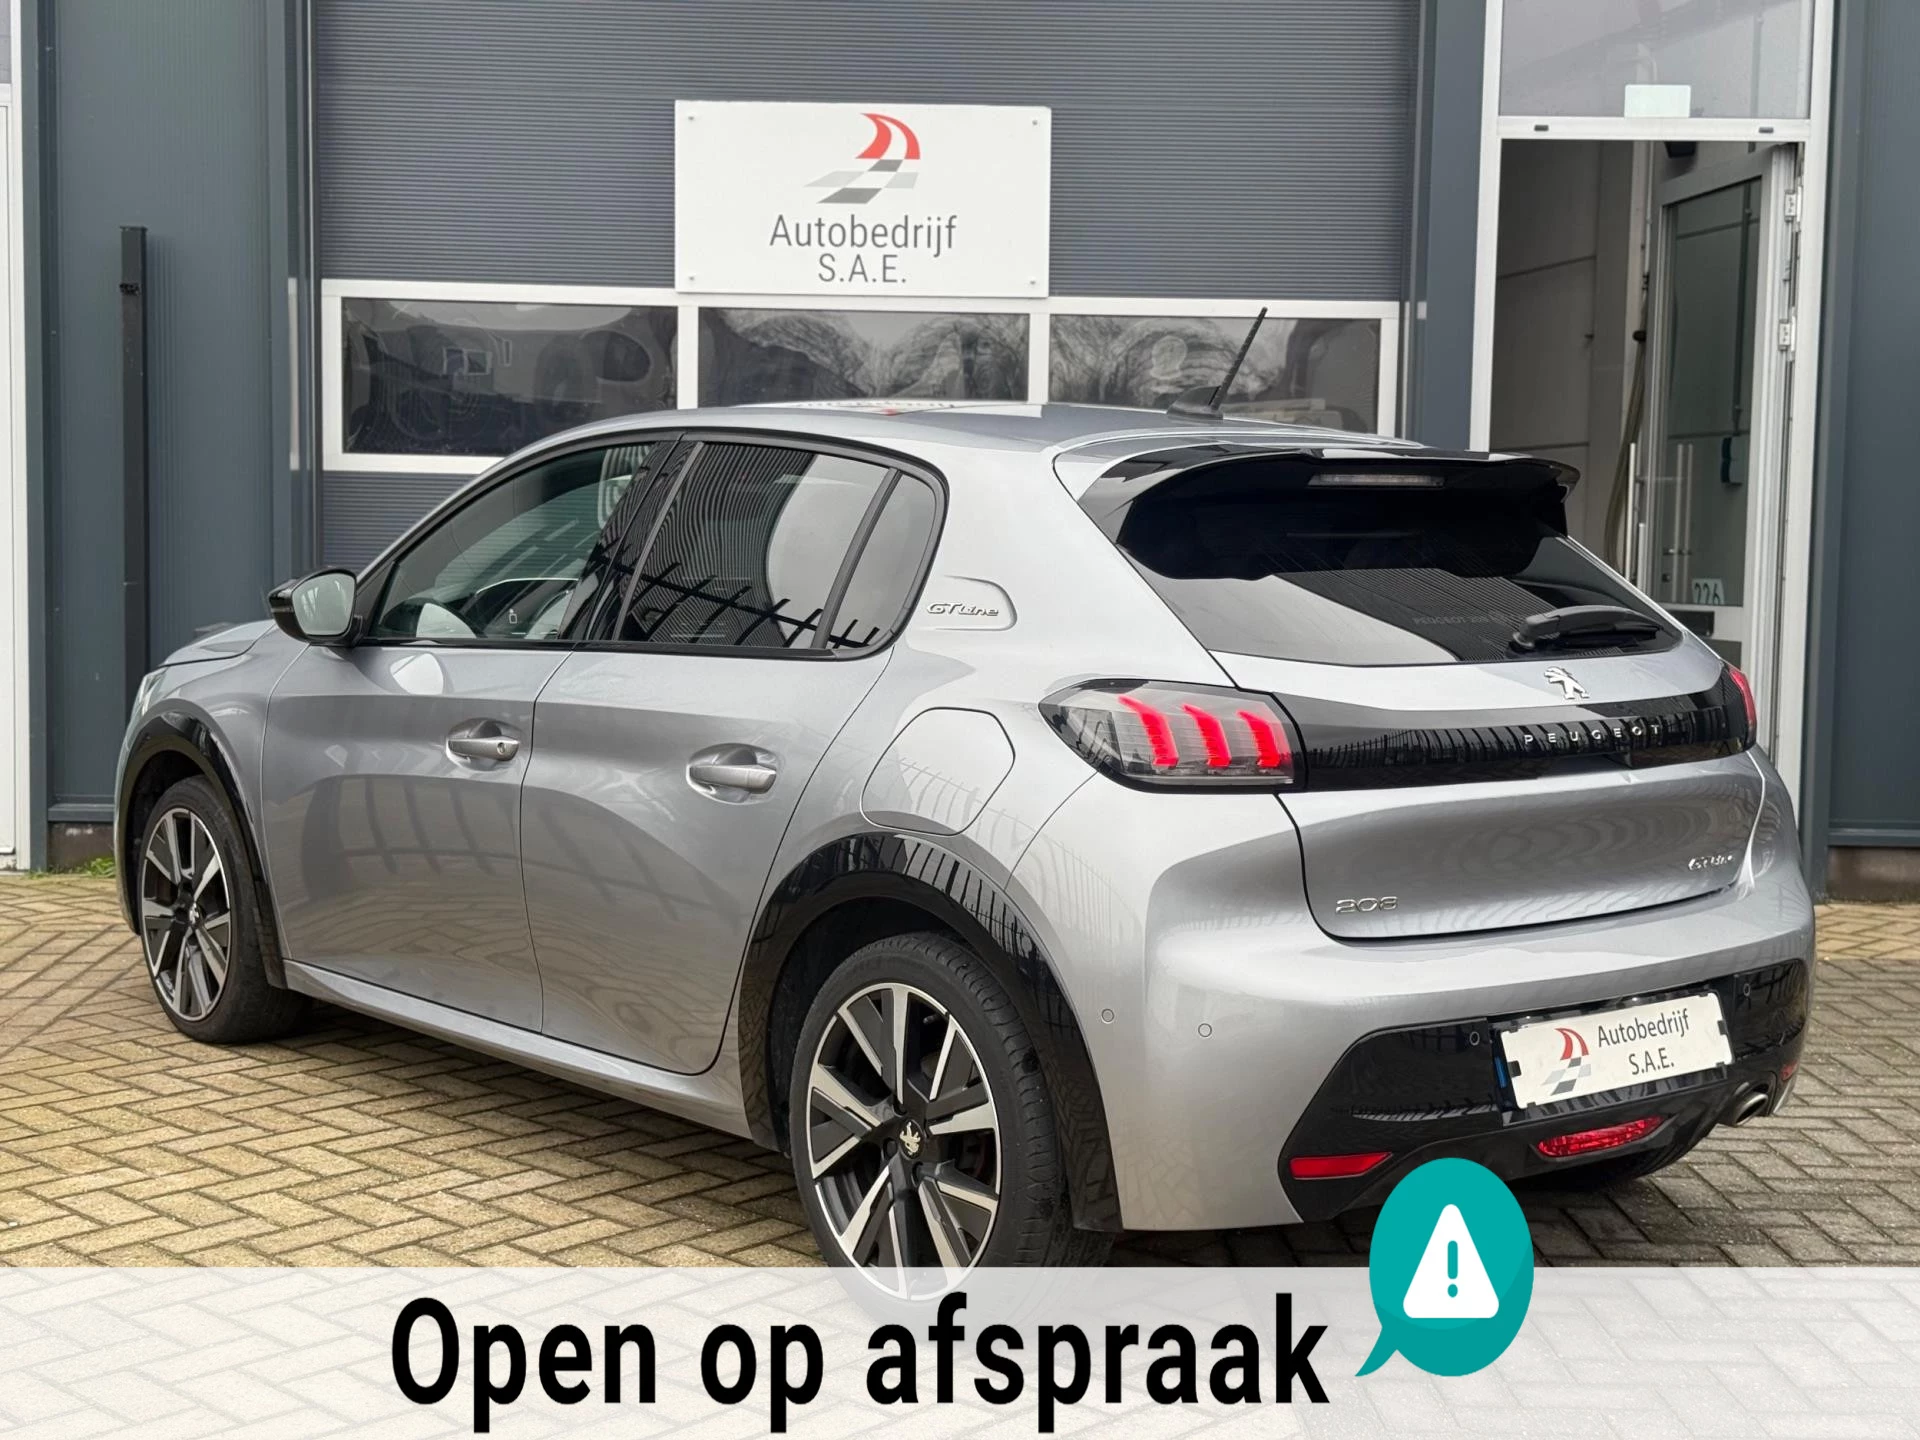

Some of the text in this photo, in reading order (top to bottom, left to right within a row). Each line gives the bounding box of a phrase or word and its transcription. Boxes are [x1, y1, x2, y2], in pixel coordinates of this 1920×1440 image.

[769, 213, 958, 258] Autobedrijf
[818, 252, 907, 284] S.A.E.
[1523, 723, 1661, 747] PEUGEOT
[1335, 896, 1397, 913] 208
[1597, 1007, 1690, 1048] Autobedrijf
[1628, 1047, 1675, 1076] S.A.E.
